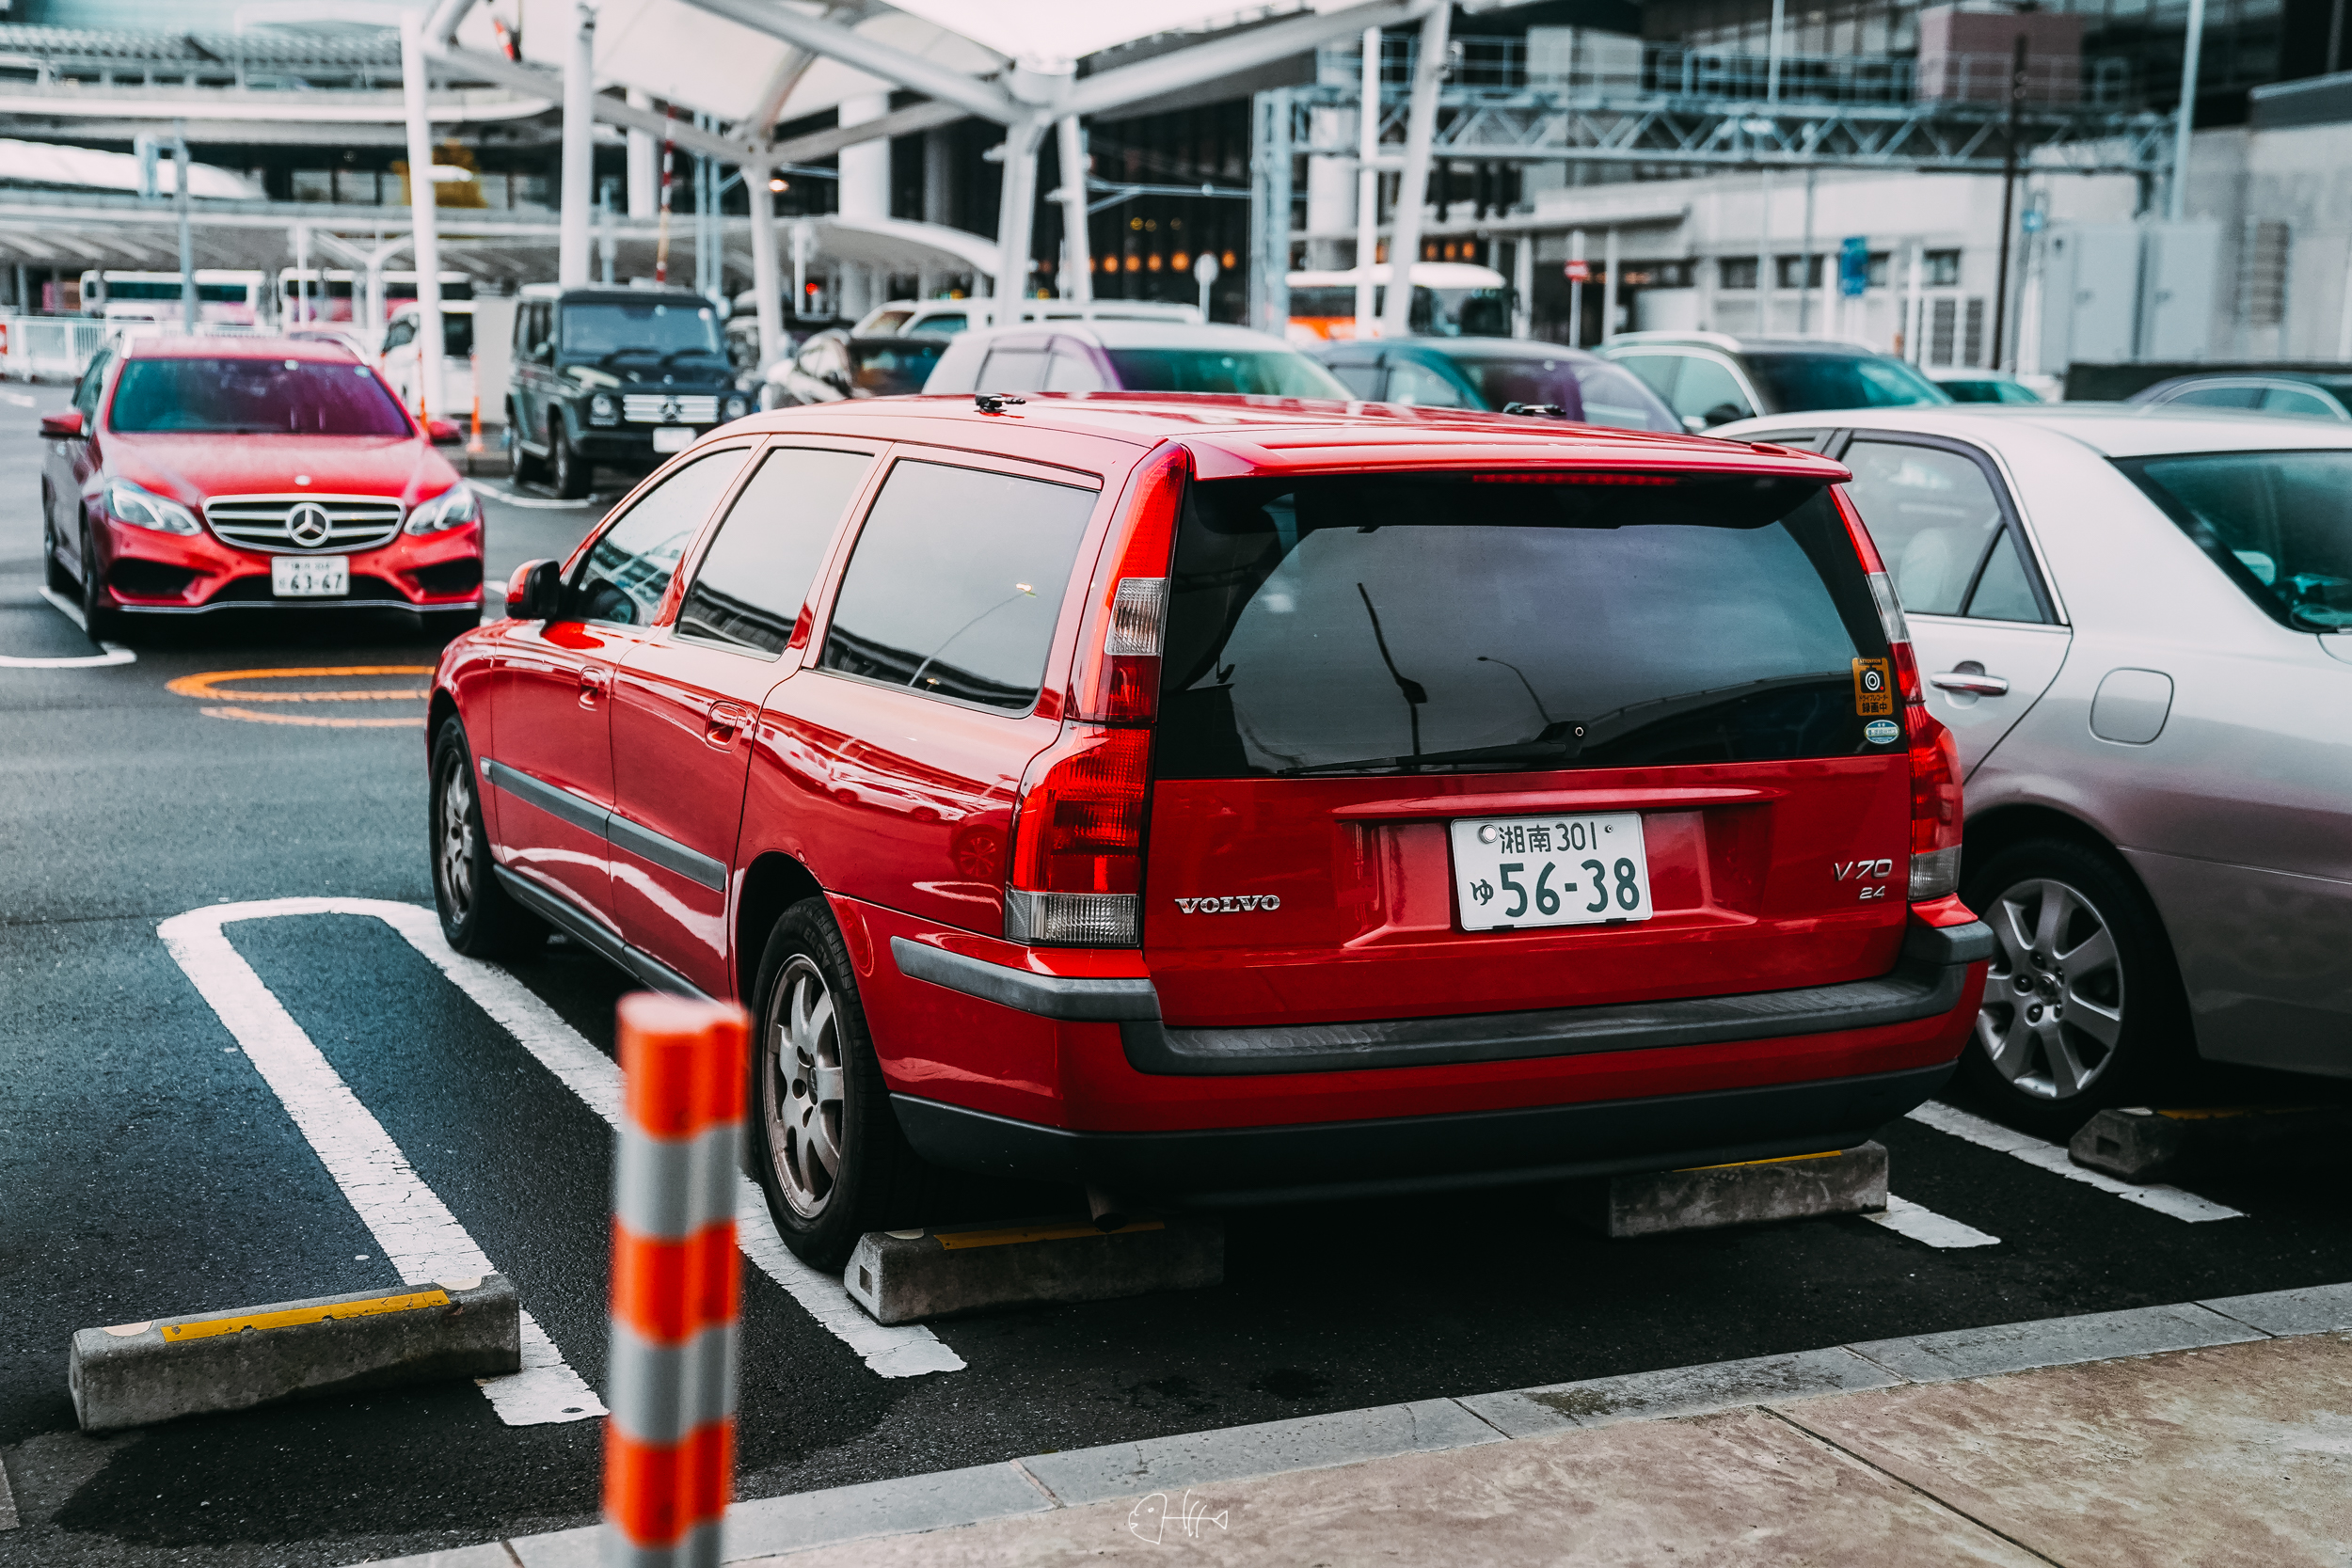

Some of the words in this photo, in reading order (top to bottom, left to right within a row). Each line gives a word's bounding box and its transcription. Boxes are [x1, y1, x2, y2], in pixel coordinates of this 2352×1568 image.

[1862, 702, 1887, 713] 録画中
[1834, 859, 1893, 881] V70
[1470, 879, 1494, 906] ゆ
[1500, 857, 1640, 917] 56-38
[1174, 895, 1280, 914] VOLVO
